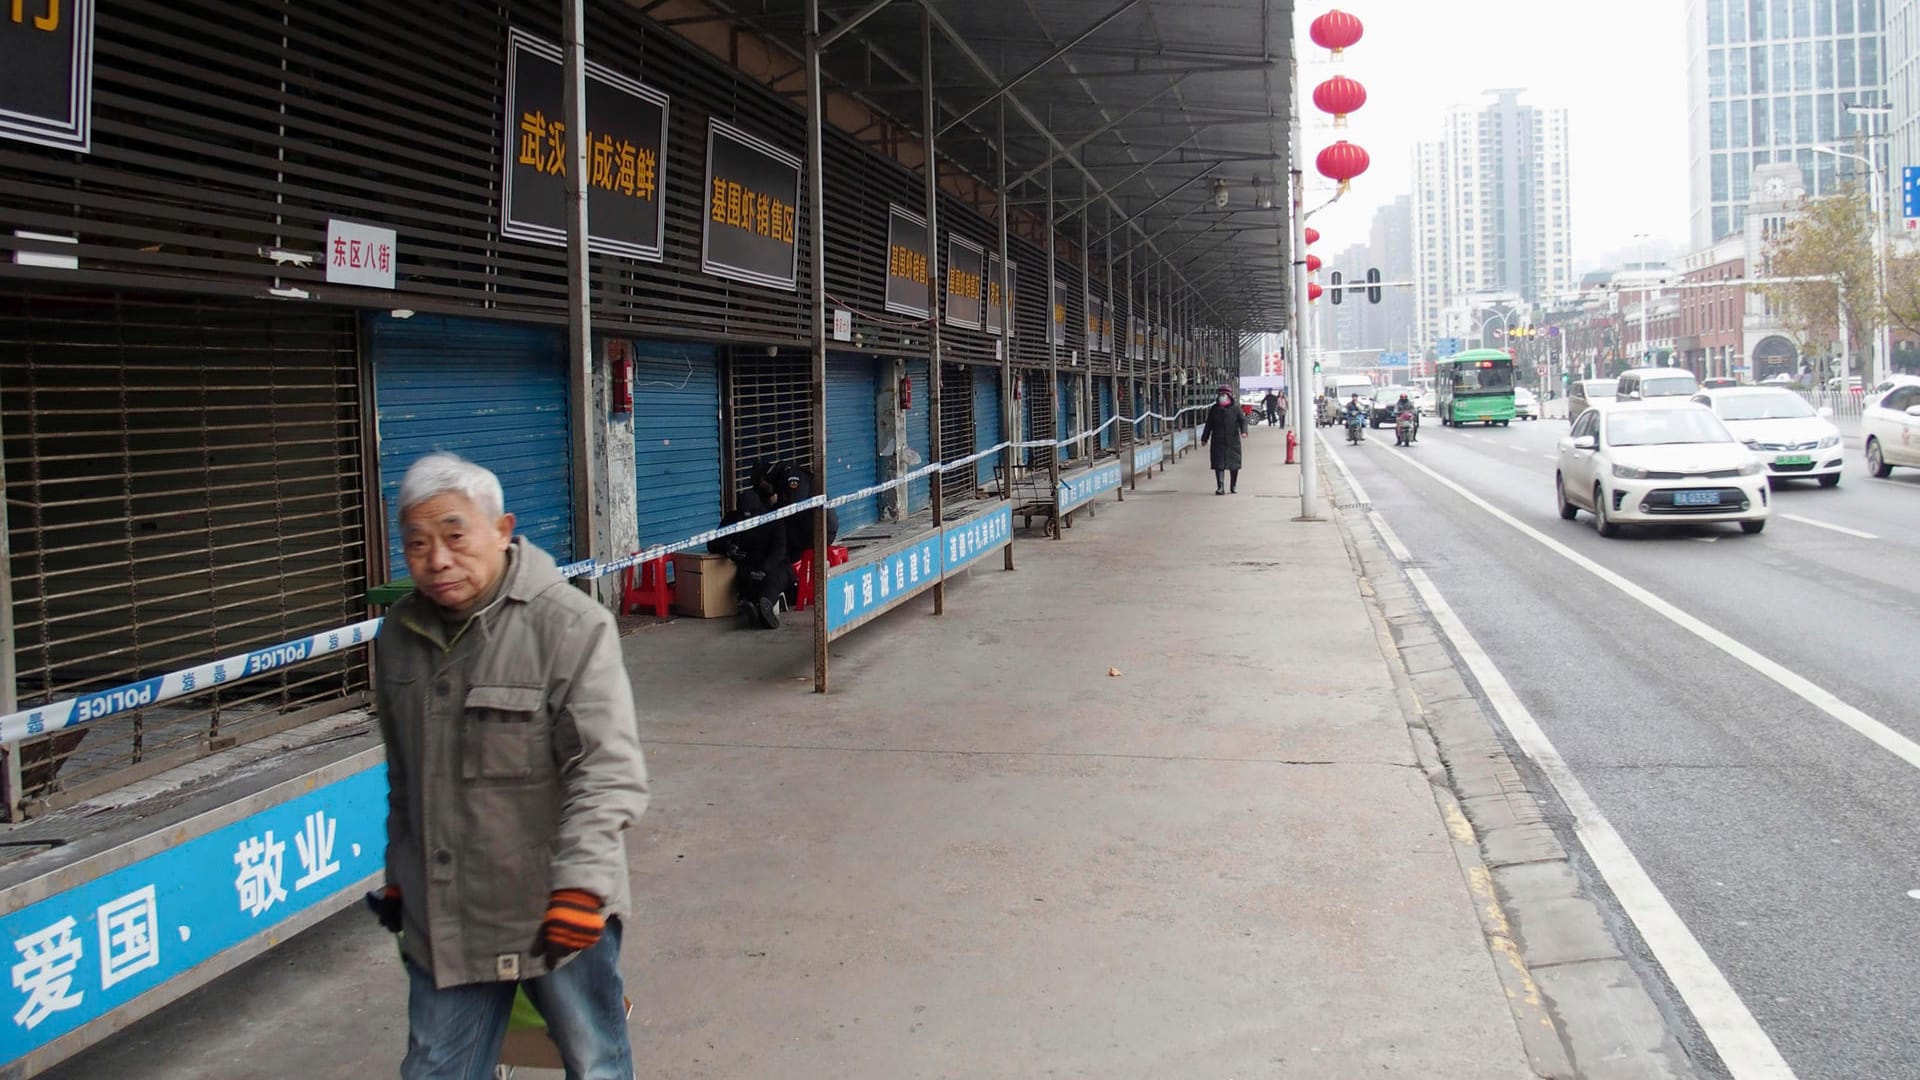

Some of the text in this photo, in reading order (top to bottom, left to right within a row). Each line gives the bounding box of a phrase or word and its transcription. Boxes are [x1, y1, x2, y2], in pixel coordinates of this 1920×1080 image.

[519, 110, 656, 201] 武汉成海鲜
[711, 176, 795, 245] 基围虾销售区
[333, 236, 391, 273] 东区八街
[843, 546, 931, 615] 加强诚信建设
[250, 642, 306, 673] POLICE
[78, 684, 153, 723] POLICE
